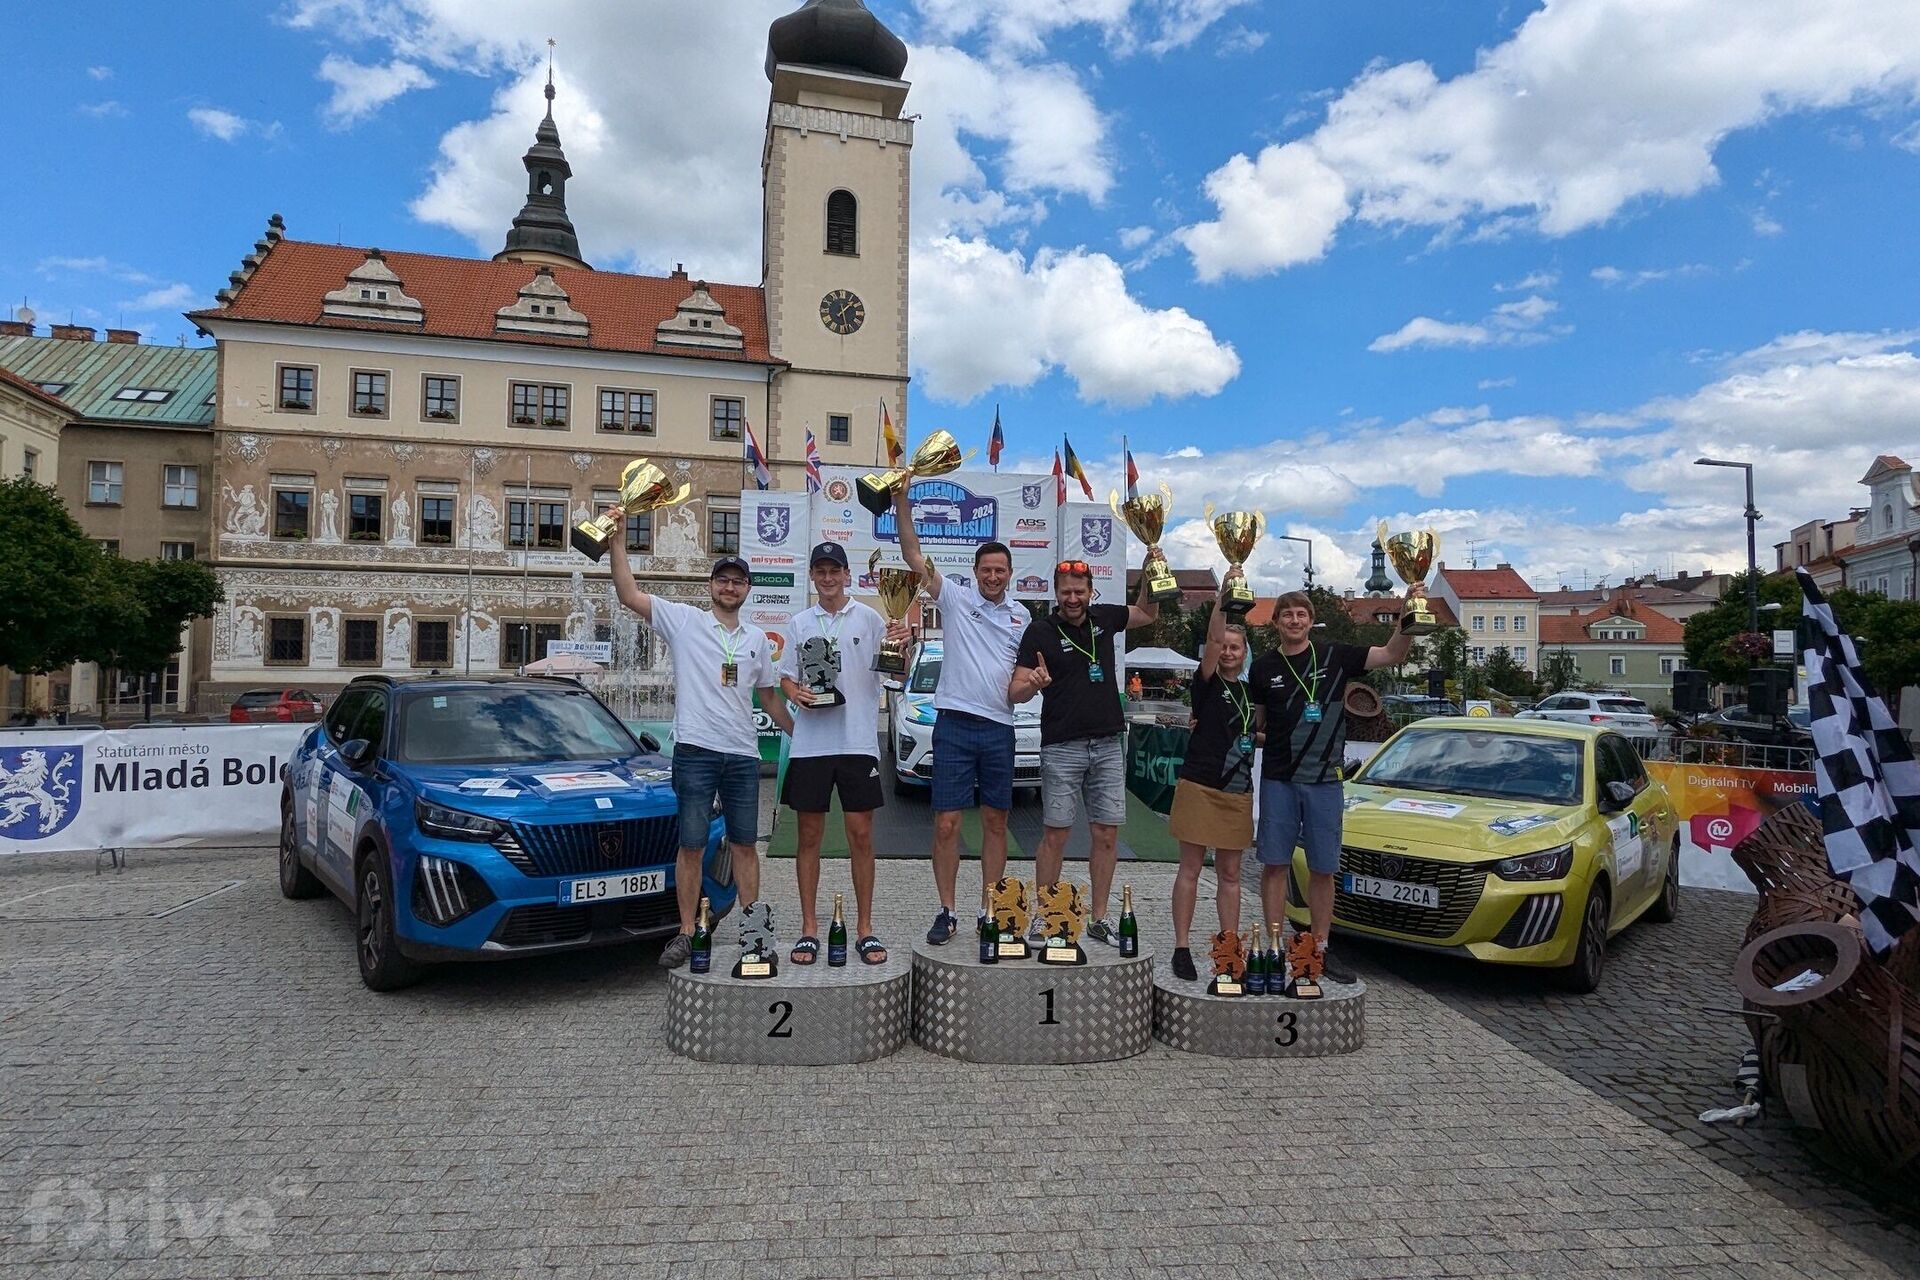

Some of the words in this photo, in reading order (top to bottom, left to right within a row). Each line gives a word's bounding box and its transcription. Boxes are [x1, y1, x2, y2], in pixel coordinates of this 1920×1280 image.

[972, 503, 994, 520] 2024
[946, 516, 994, 537] BOLESLAV
[1016, 518, 1046, 527] ABS
[1090, 565, 1113, 576] MPAG
[96, 744, 164, 759] Statutární
[168, 743, 210, 756] město
[94, 758, 210, 793] Mladá
[1688, 775, 1738, 788] Digitální
[1742, 779, 1756, 790] TV
[1773, 782, 1817, 794] Mobiln
[575, 880, 607, 900] EL3
[620, 874, 658, 894] 18BX
[1355, 878, 1381, 896] EL2
[1393, 885, 1430, 904] 22CA
[1038, 988, 1060, 1025] 1
[767, 1001, 794, 1038] 2
[1274, 1012, 1298, 1047] 3
